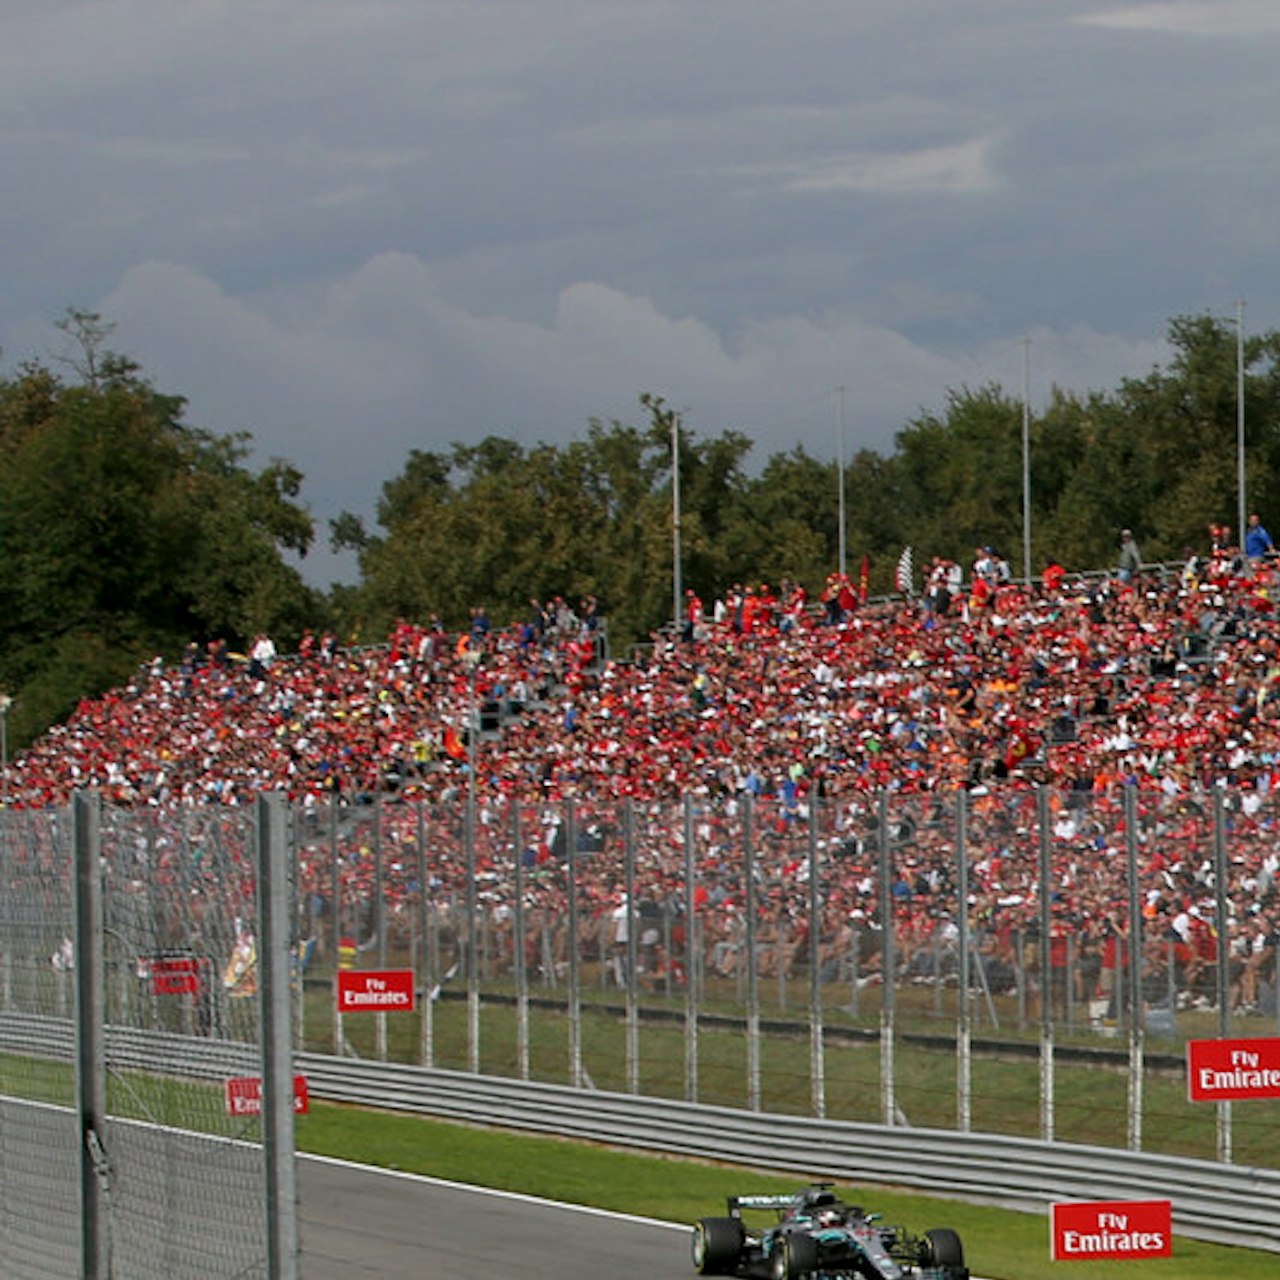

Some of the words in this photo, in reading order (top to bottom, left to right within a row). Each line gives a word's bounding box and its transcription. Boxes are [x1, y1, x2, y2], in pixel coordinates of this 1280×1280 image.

[344, 989, 409, 1005] Emirates
[1231, 1051, 1259, 1068] Fly
[1098, 1213, 1128, 1230] Fly
[1063, 1229, 1164, 1252] Emirates
